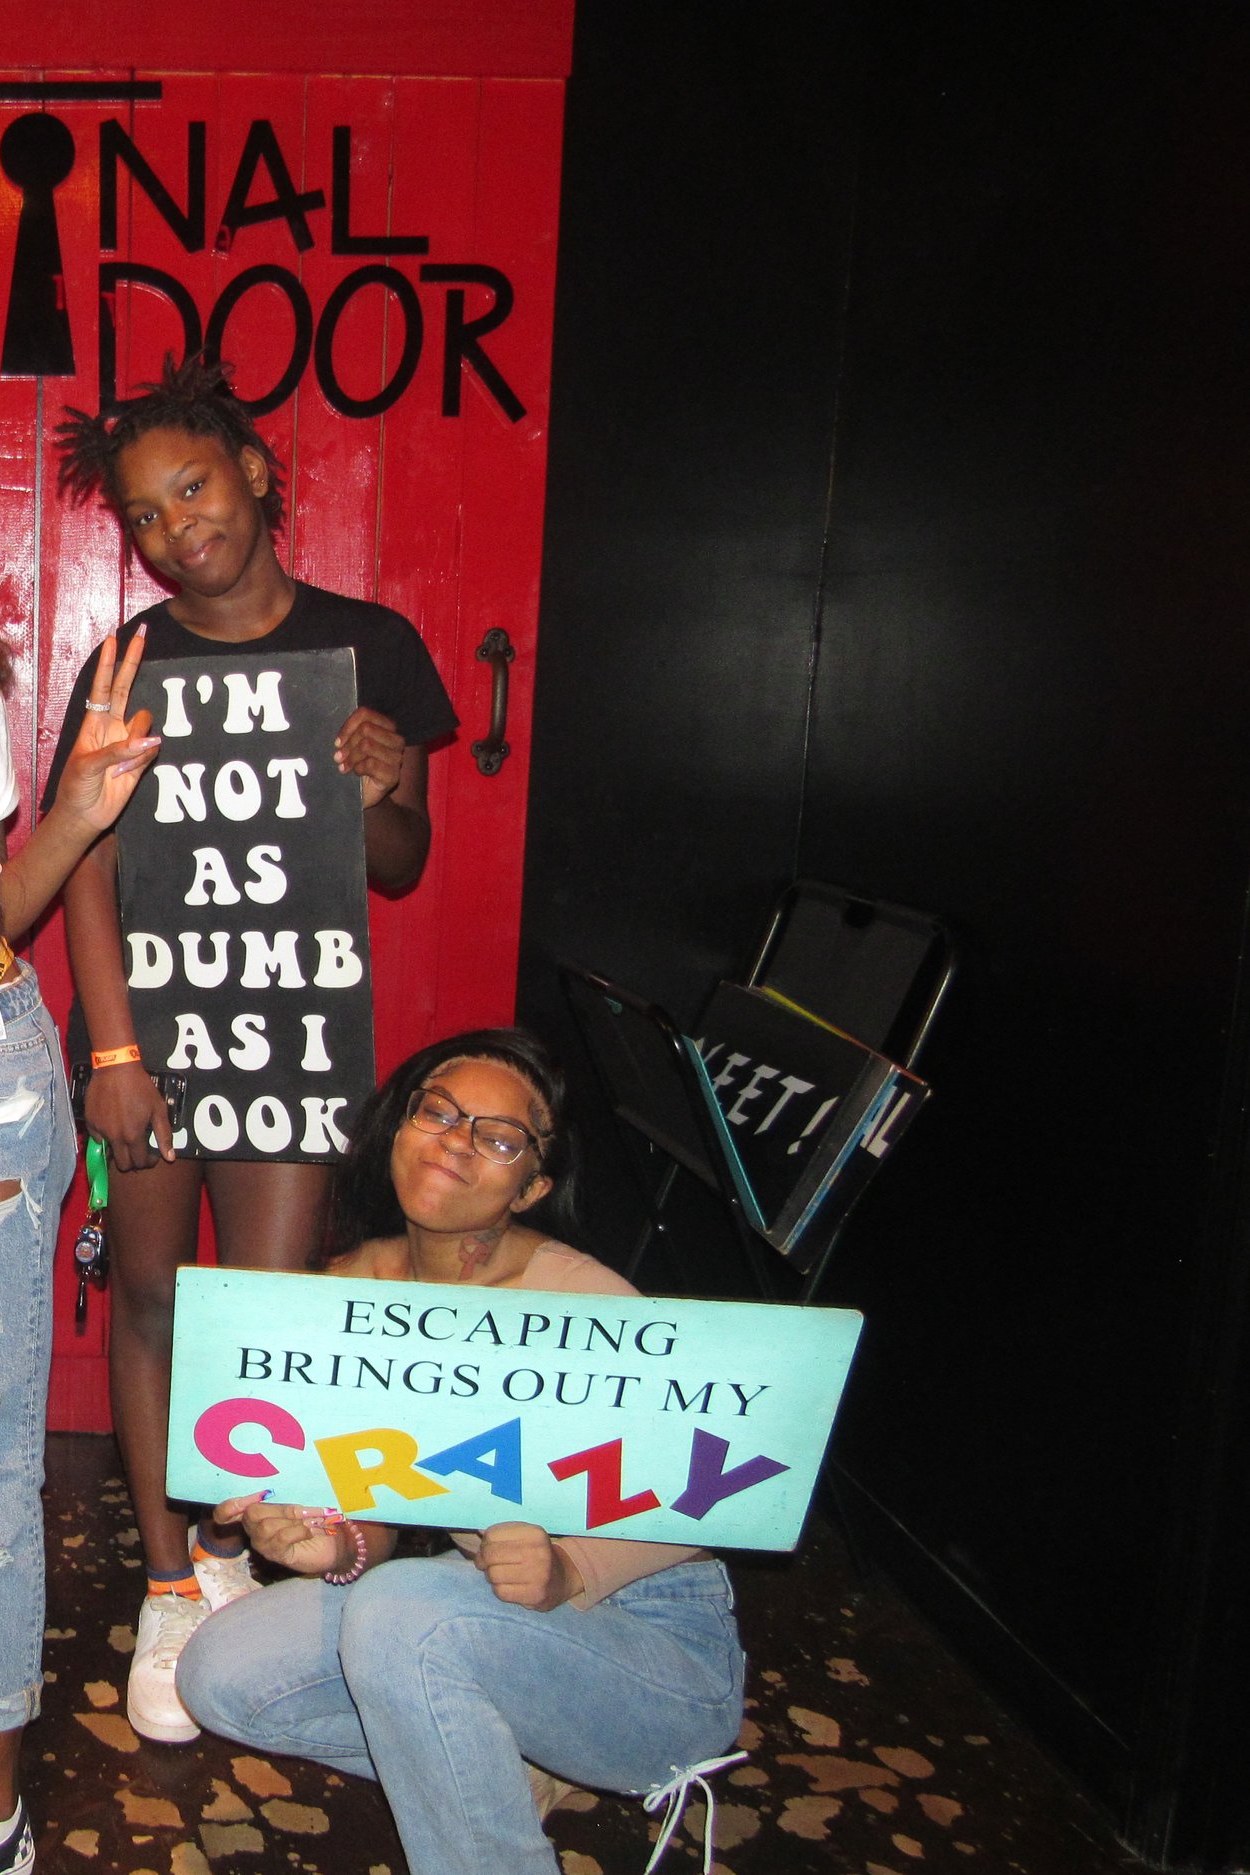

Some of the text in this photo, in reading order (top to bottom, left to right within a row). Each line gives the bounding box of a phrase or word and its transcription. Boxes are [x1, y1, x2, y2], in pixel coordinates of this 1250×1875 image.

[99, 262, 527, 423] DOOR
[161, 671, 290, 738] I'M
[153, 757, 309, 823] NOT
[184, 845, 287, 906] AS
[126, 930, 363, 989] DUMB
[166, 1013, 332, 1072] AS I
[341, 1299, 680, 1356] ESCAPING
[236, 1346, 772, 1417] BRINGS OUT MY
[193, 1397, 791, 1530] CRAZY
